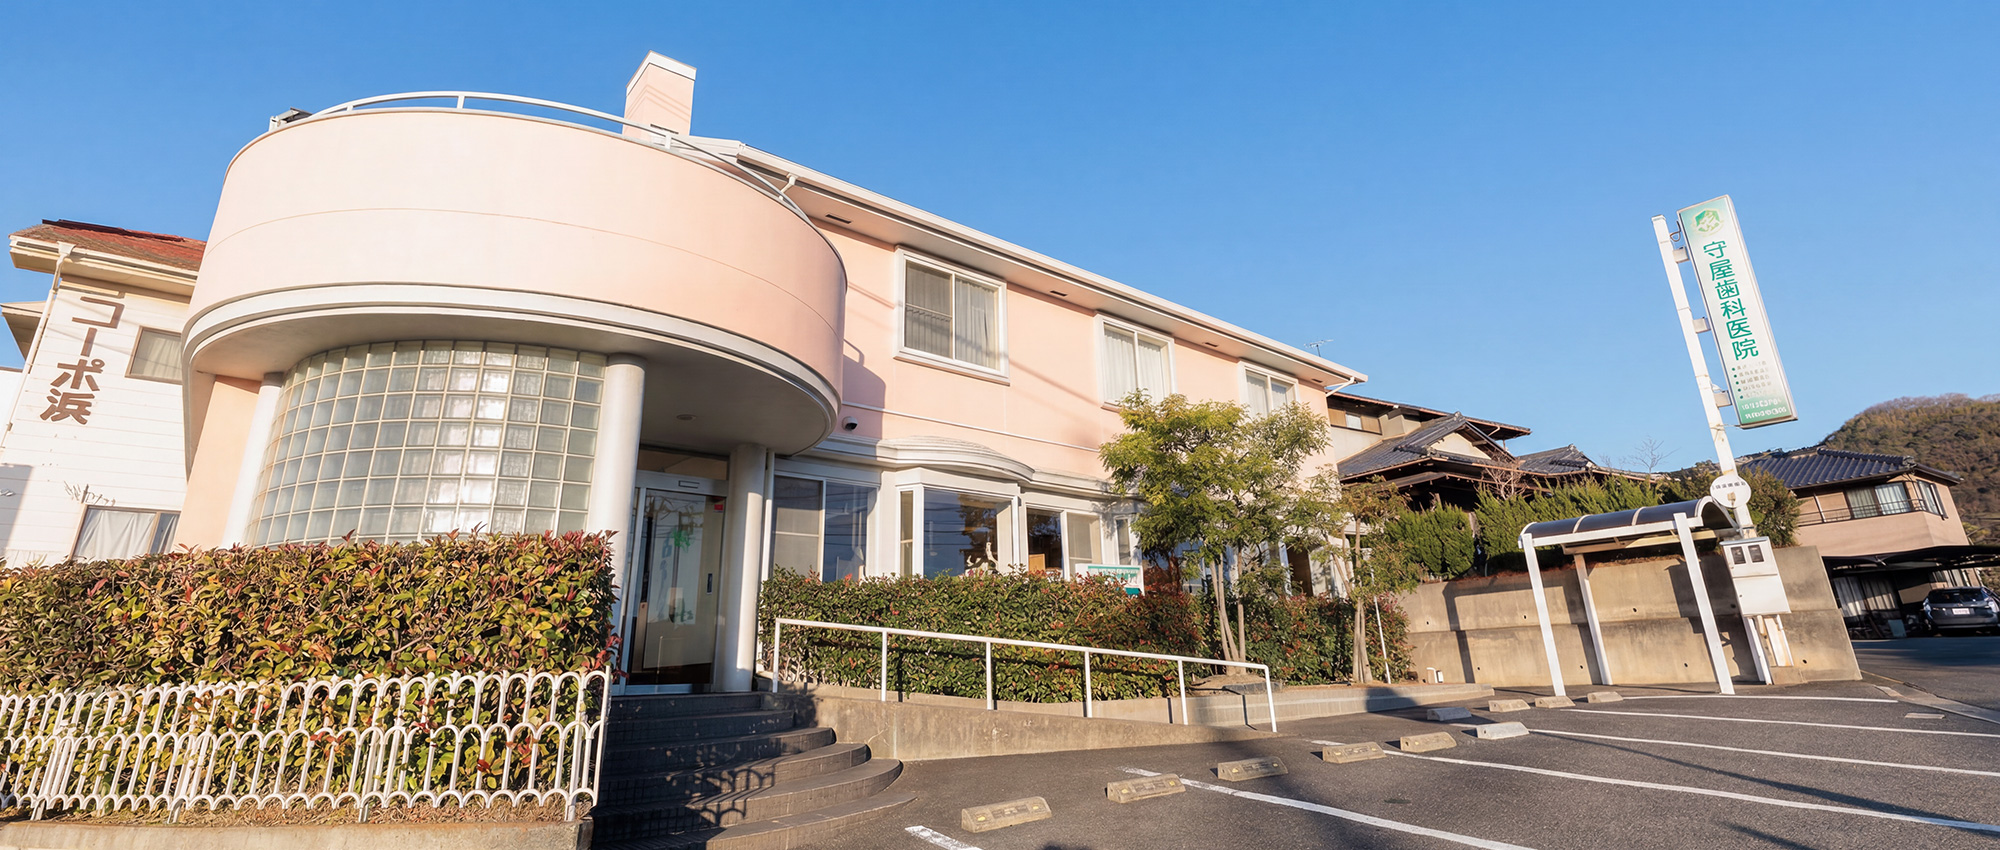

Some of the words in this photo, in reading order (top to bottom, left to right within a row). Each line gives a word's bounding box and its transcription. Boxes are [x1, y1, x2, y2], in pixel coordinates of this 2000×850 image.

[39, 296, 125, 425] コーポ浜
[1703, 240, 1759, 361] 守屋歯科医院
